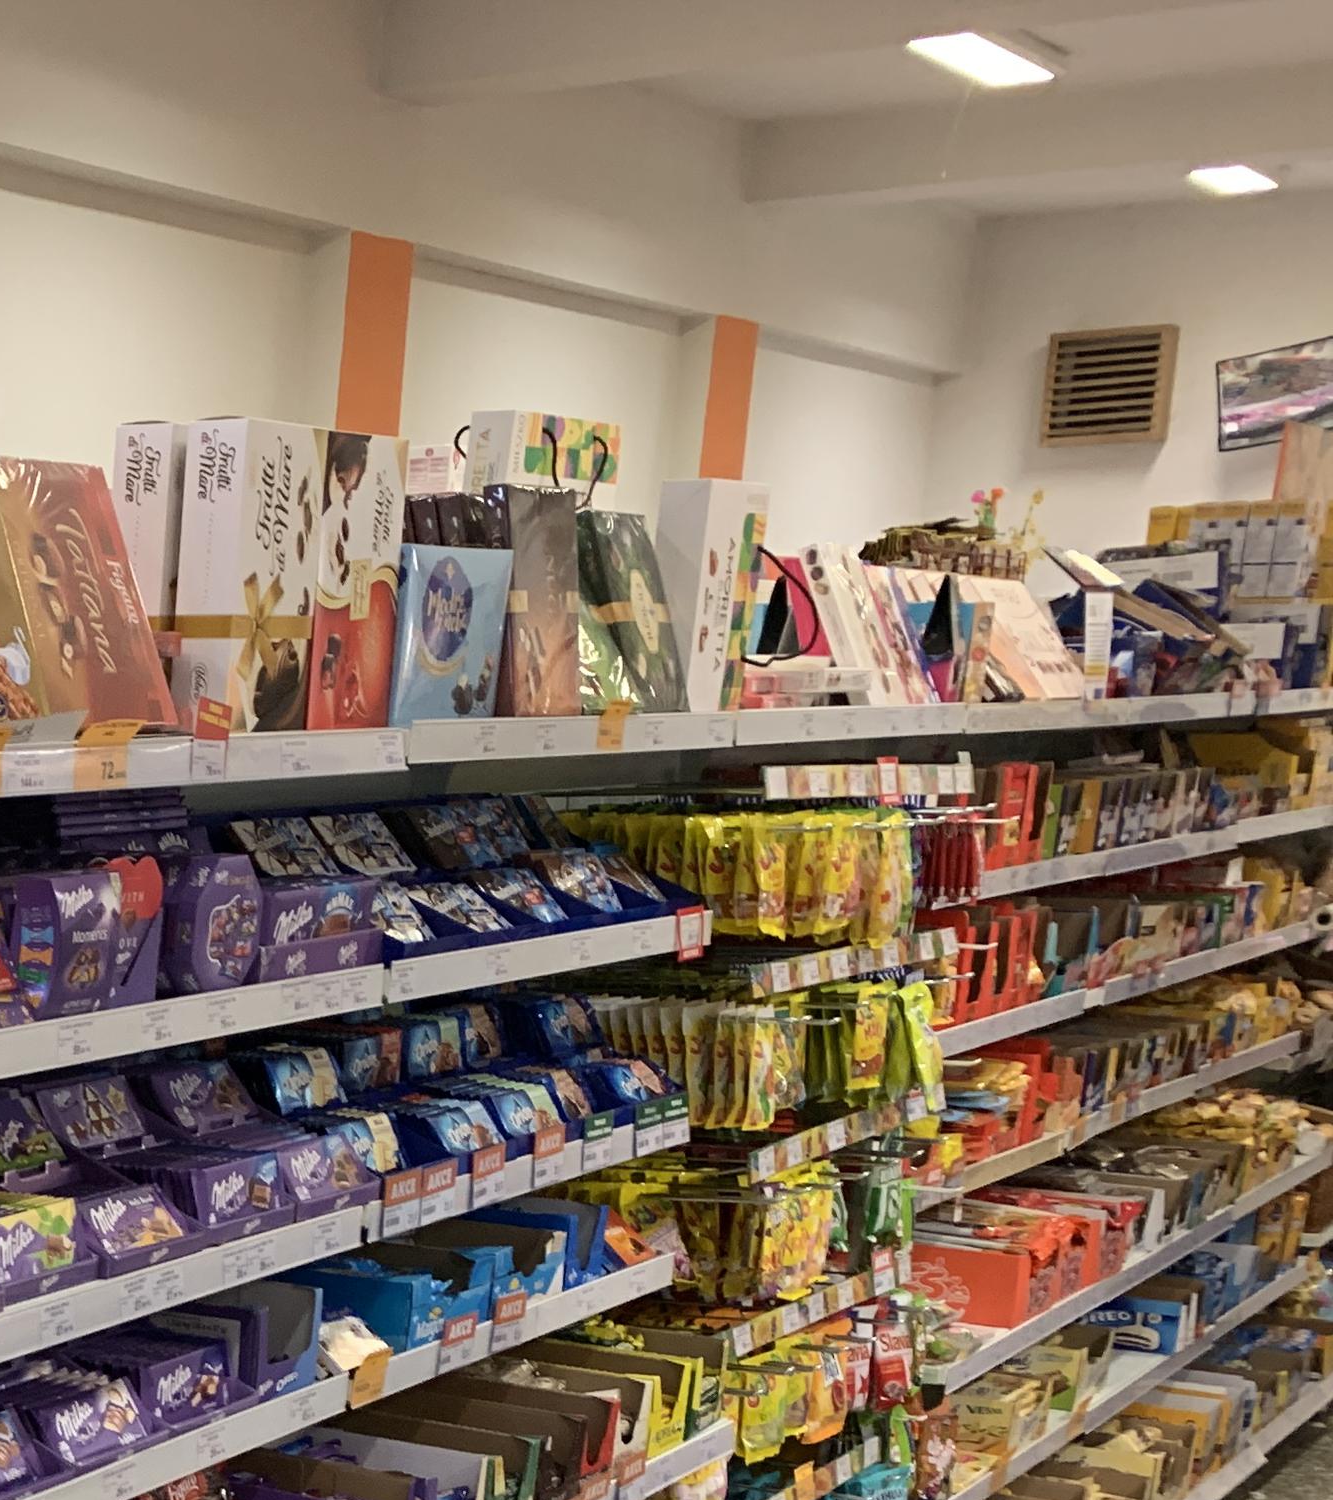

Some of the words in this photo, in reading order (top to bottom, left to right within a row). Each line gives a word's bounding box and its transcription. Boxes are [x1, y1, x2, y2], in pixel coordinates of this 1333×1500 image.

[210, 1173, 245, 1211] Milka
[91, 1200, 127, 1233] Milka
[55, 1403, 92, 1436] Milka
